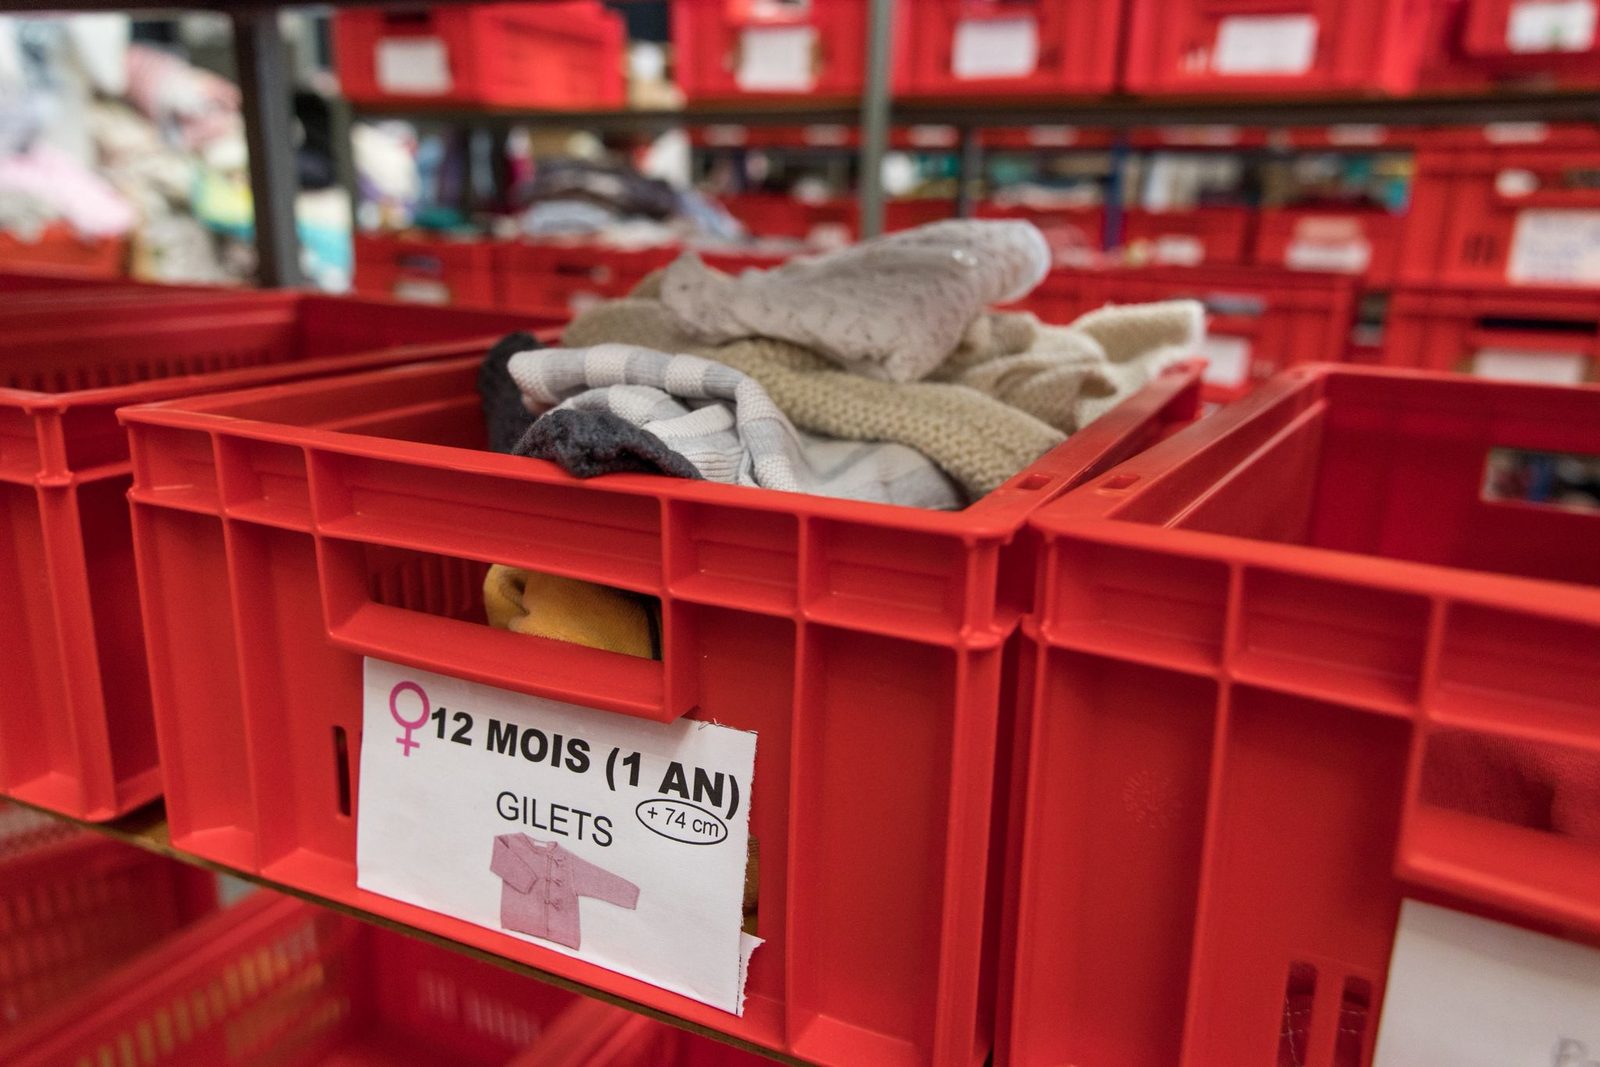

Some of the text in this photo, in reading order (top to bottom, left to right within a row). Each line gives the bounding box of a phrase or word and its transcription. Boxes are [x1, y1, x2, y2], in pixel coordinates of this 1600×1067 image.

[431, 706, 741, 821] 12 MOIS (1 AN)
[496, 791, 613, 848] GILETS
[664, 808, 687, 830] 74
[692, 818, 720, 838] cm
